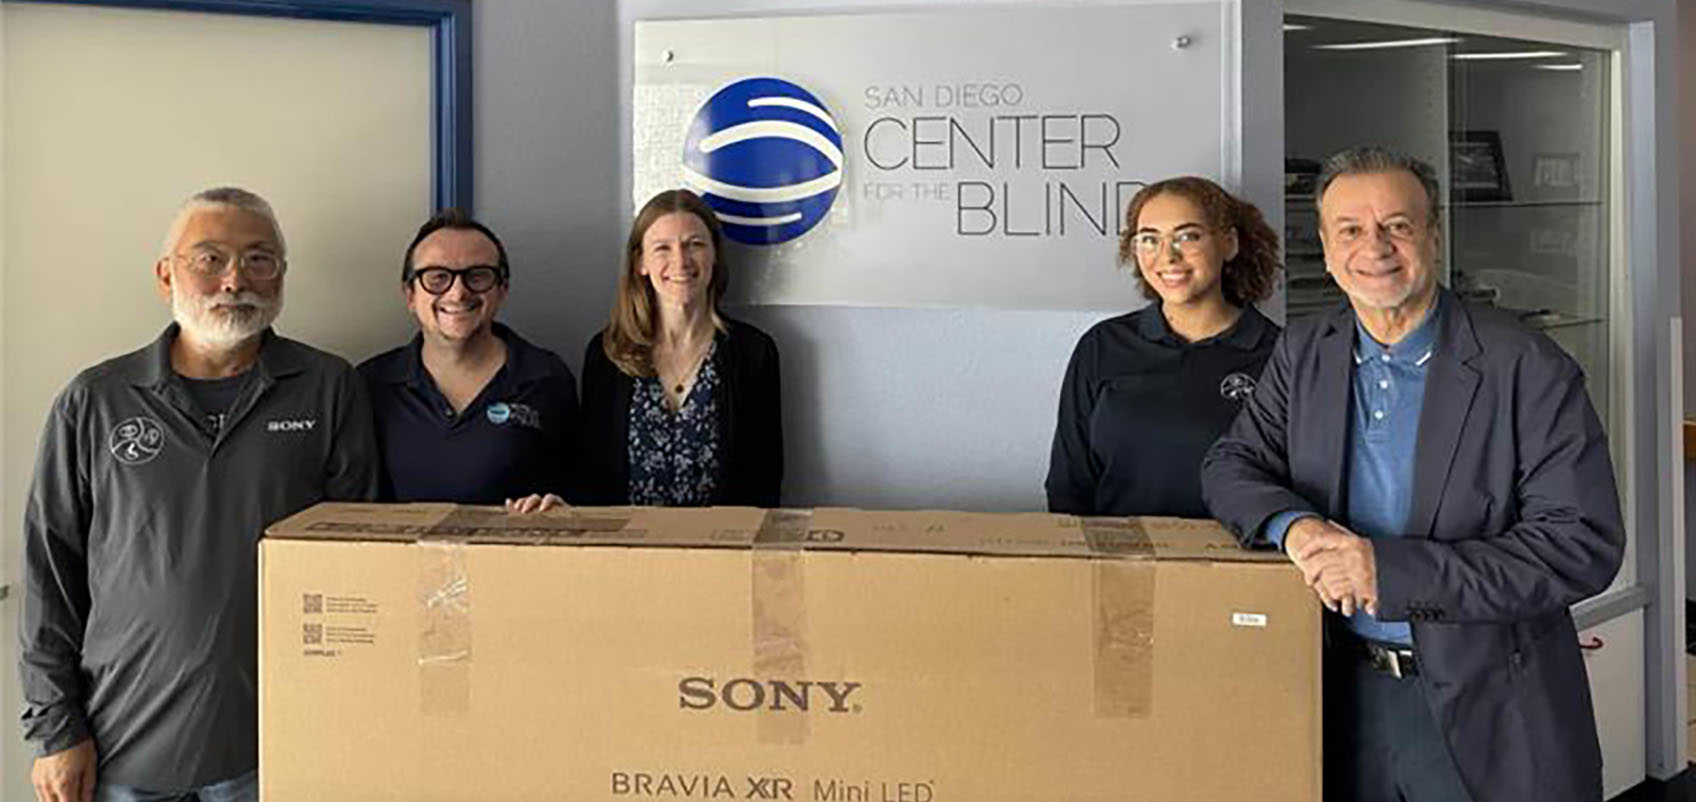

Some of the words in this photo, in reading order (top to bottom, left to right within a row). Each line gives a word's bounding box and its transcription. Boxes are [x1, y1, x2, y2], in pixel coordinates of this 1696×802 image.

[863, 85, 924, 109] SAN
[935, 83, 1024, 107] DIEGO
[864, 114, 1121, 170] CENTER
[863, 182, 904, 200] FOR
[911, 182, 951, 200] THE
[267, 419, 317, 431] SONY
[678, 676, 862, 713] SONY
[611, 772, 735, 798] BRAVIA
[813, 779, 871, 802] Mini
[880, 780, 933, 802] LED
